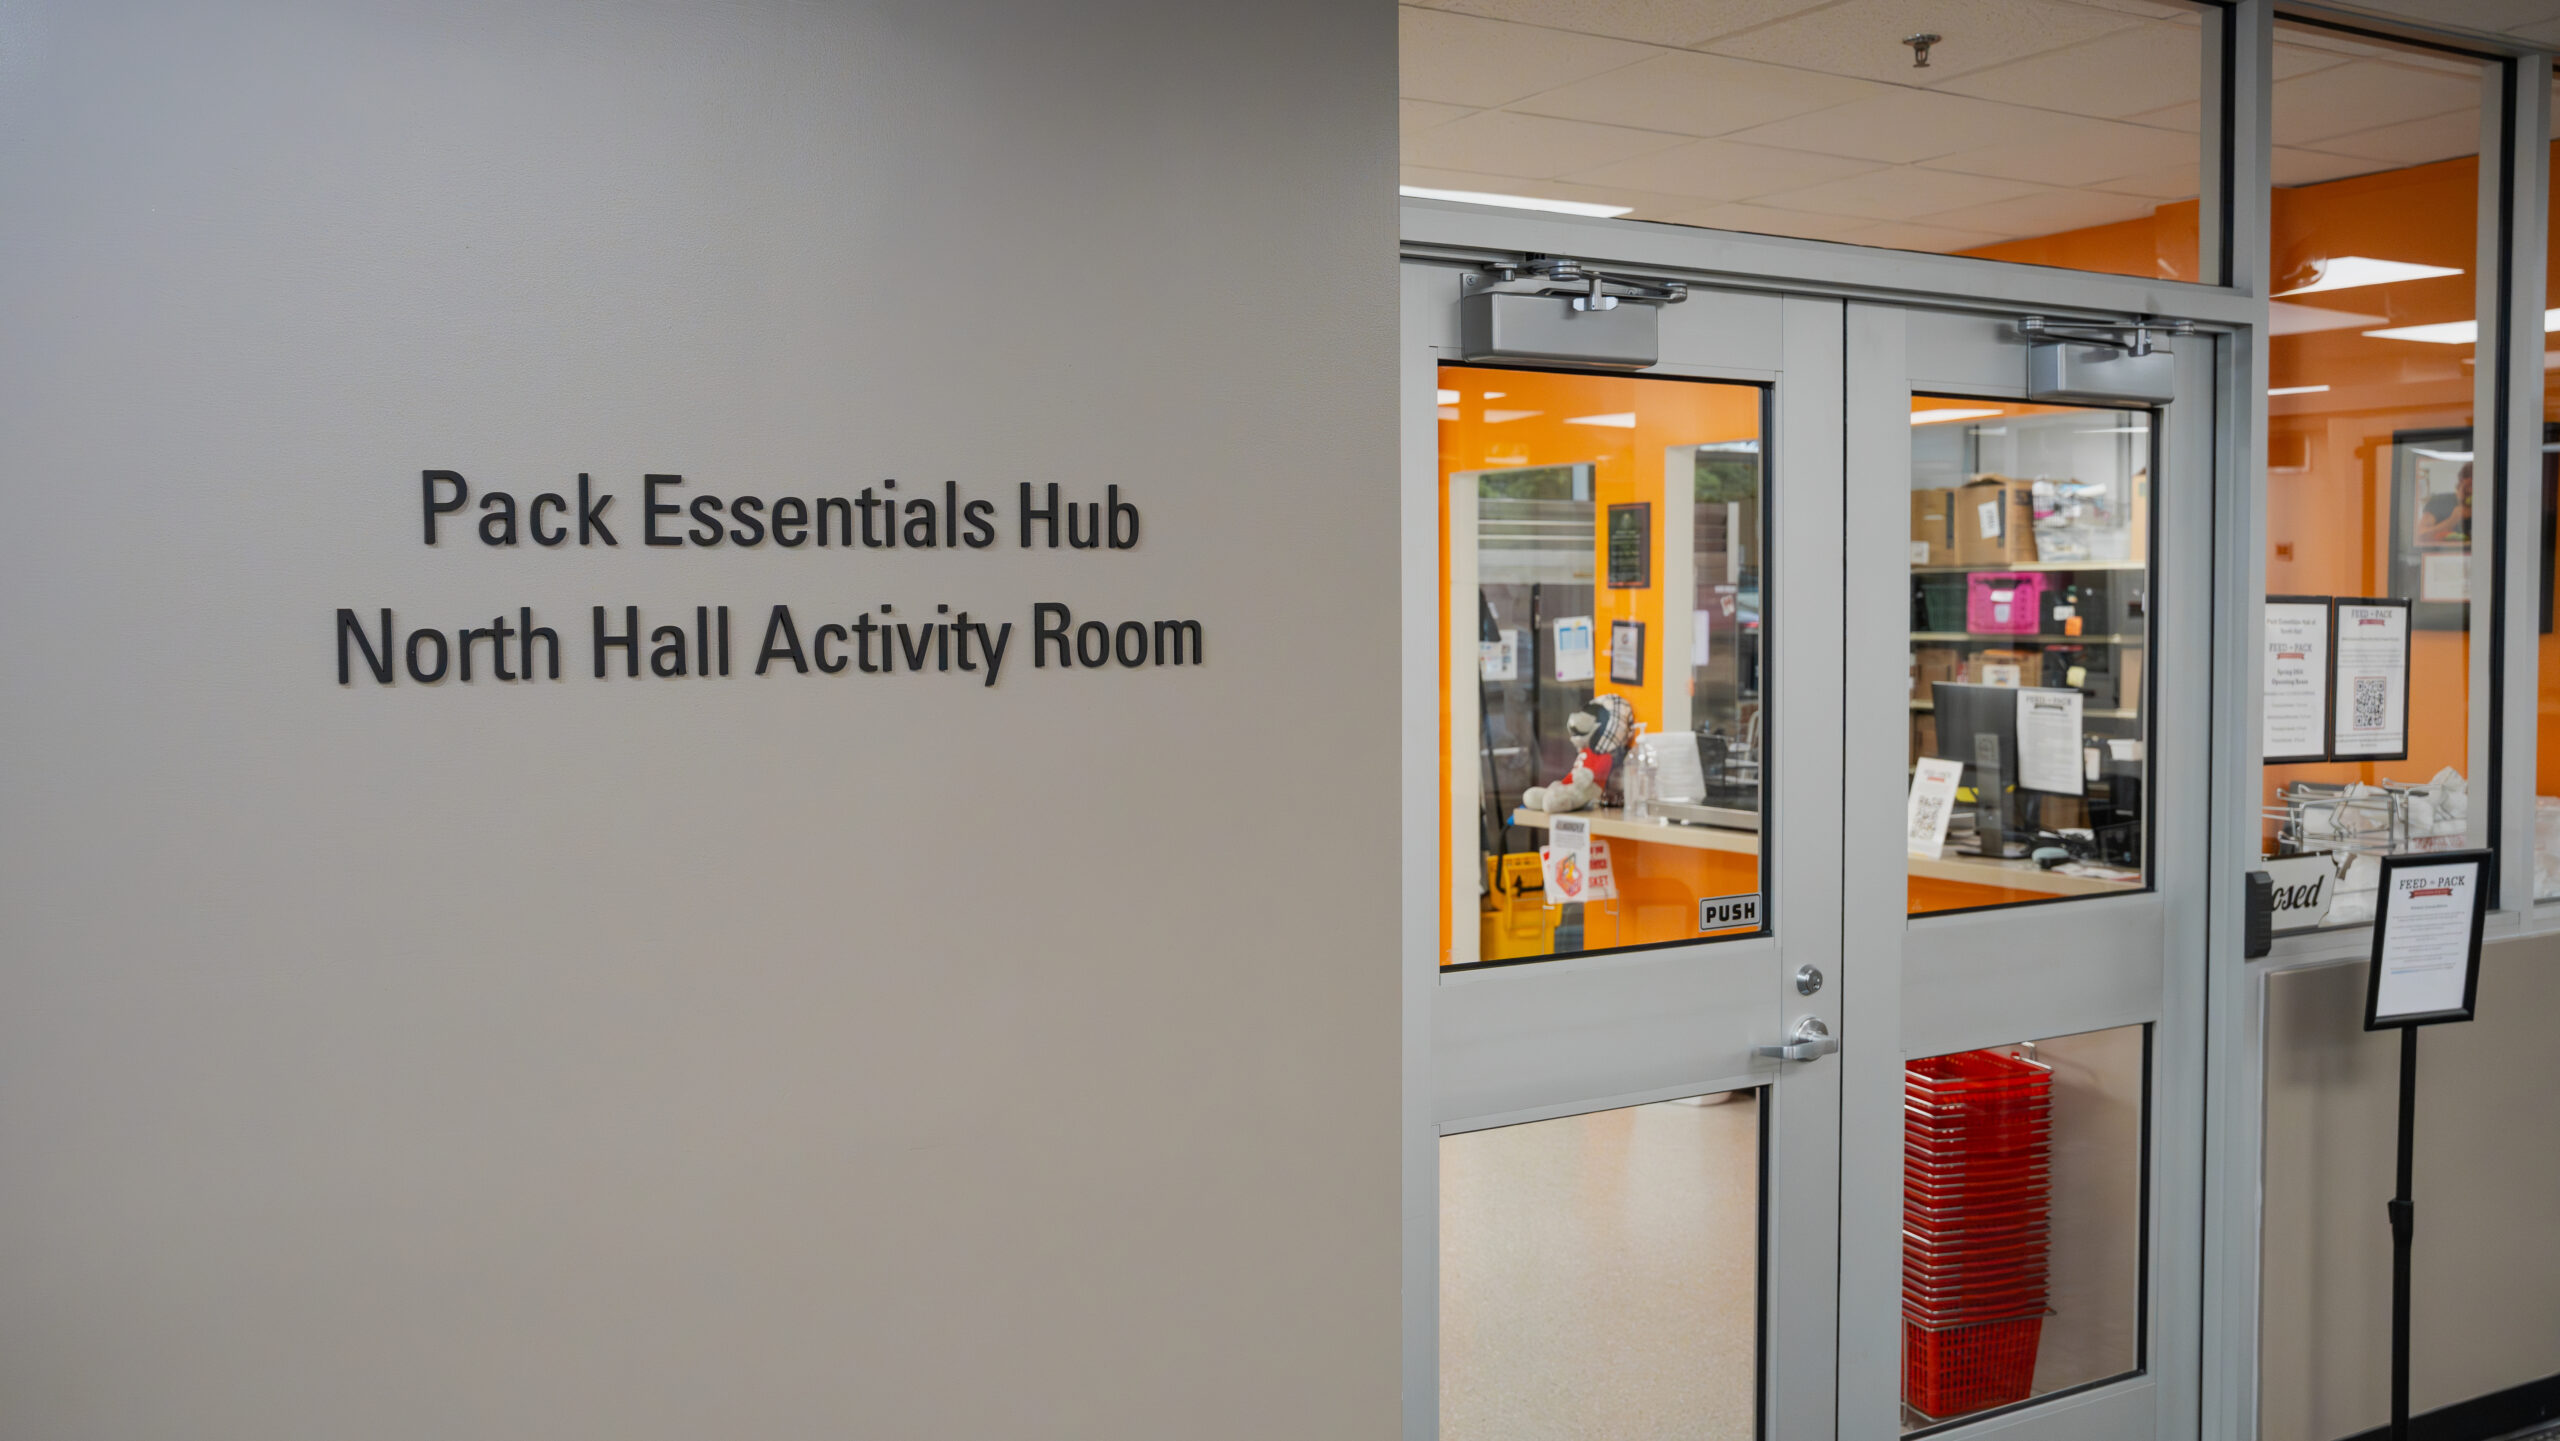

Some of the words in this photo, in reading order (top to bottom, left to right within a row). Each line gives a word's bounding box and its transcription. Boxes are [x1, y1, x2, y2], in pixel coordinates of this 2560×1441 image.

[423, 469, 619, 547] Pack
[644, 473, 996, 549] Essentials
[1019, 481, 1140, 550] Hub
[336, 606, 560, 685] North
[593, 605, 729, 679] Hall
[754, 603, 1012, 688] Activity
[1033, 602, 1203, 669] Room
[2271, 874, 2325, 912] osed
[2399, 878, 2427, 890] FEED
[2438, 875, 2466, 888] PACK
[1706, 901, 1755, 924] PUSH
